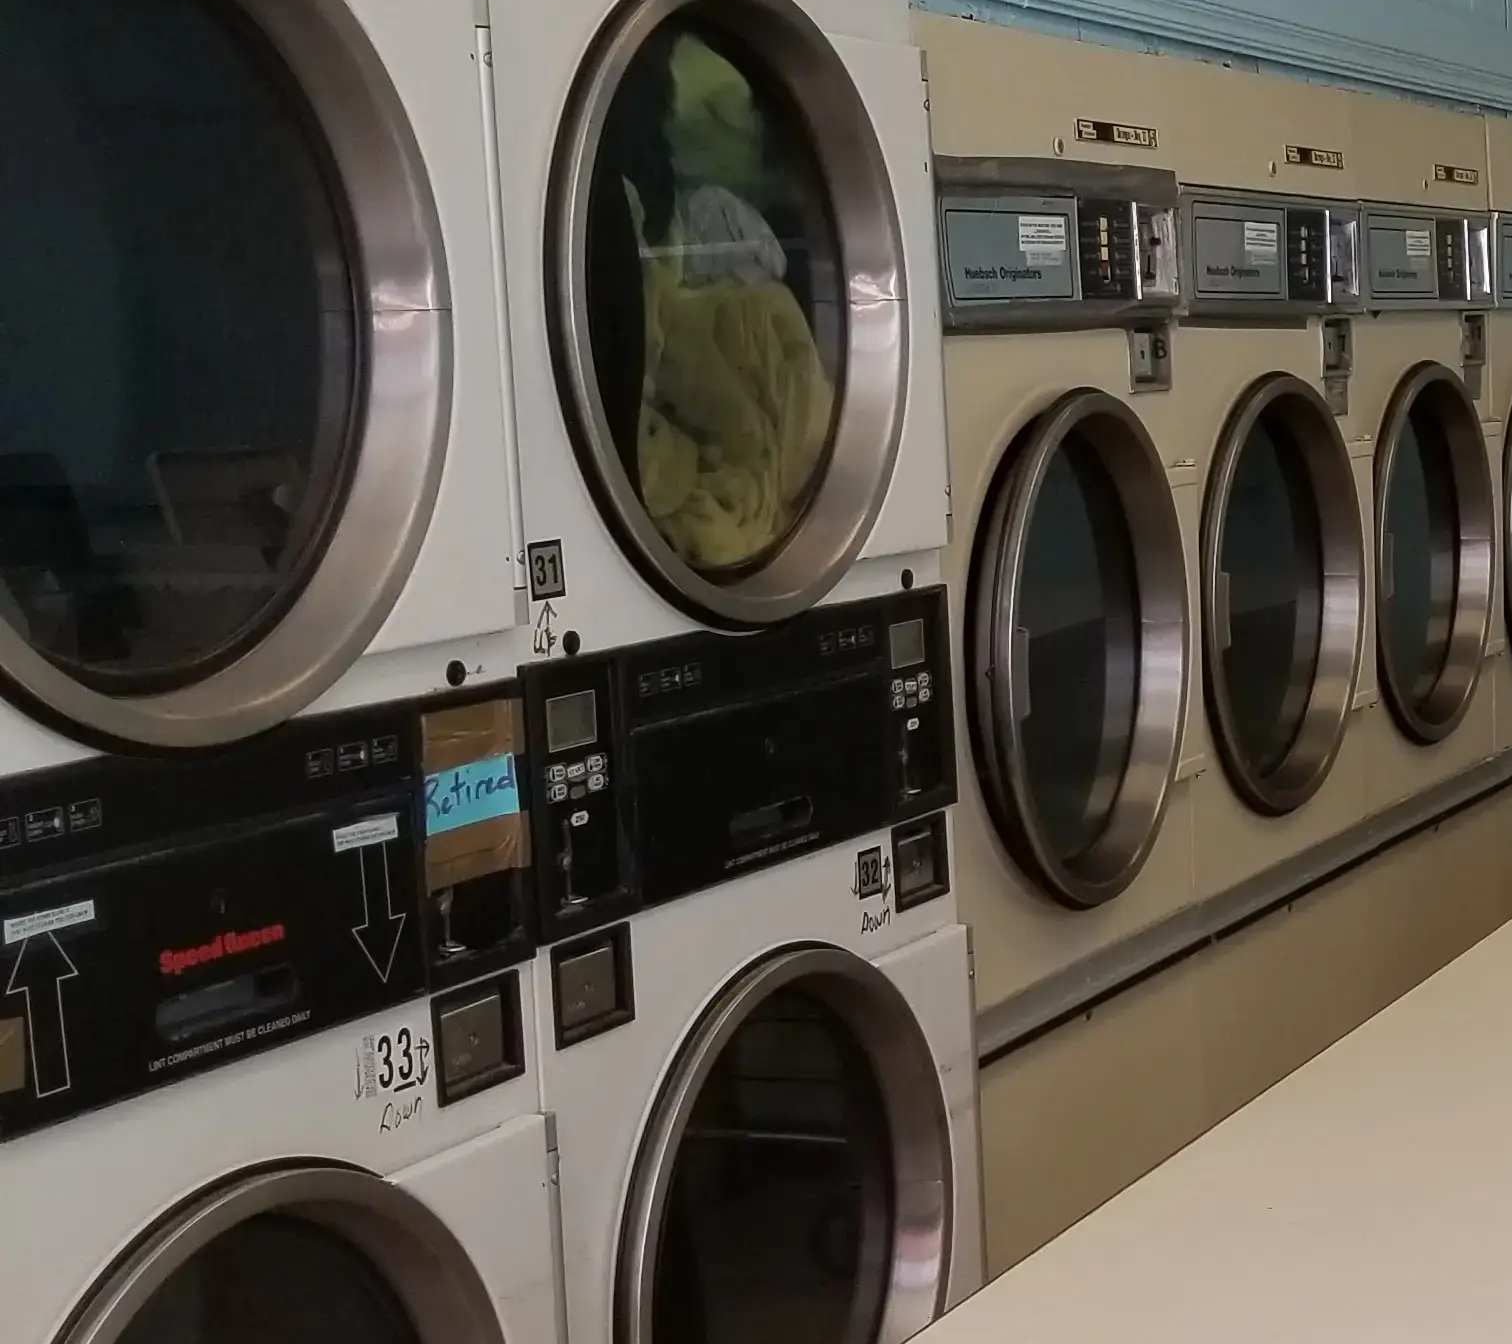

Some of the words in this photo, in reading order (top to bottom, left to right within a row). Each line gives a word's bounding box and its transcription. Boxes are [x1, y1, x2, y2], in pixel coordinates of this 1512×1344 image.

[535, 553, 559, 586] 31
[424, 756, 515, 818] Retired
[862, 859, 880, 887] 32
[861, 906, 891, 934] Down
[160, 936, 223, 974] Speed
[224, 924, 284, 953] Queen
[149, 1058, 166, 1072] LINT
[167, 1039, 223, 1066] COMPARTMENT
[224, 1032, 245, 1047] MUST
[246, 1028, 256, 1039] BE
[257, 1017, 291, 1035] CLEANED
[292, 1009, 311, 1025] DAILY
[377, 1027, 413, 1089] 33
[380, 1096, 422, 1134] Down
